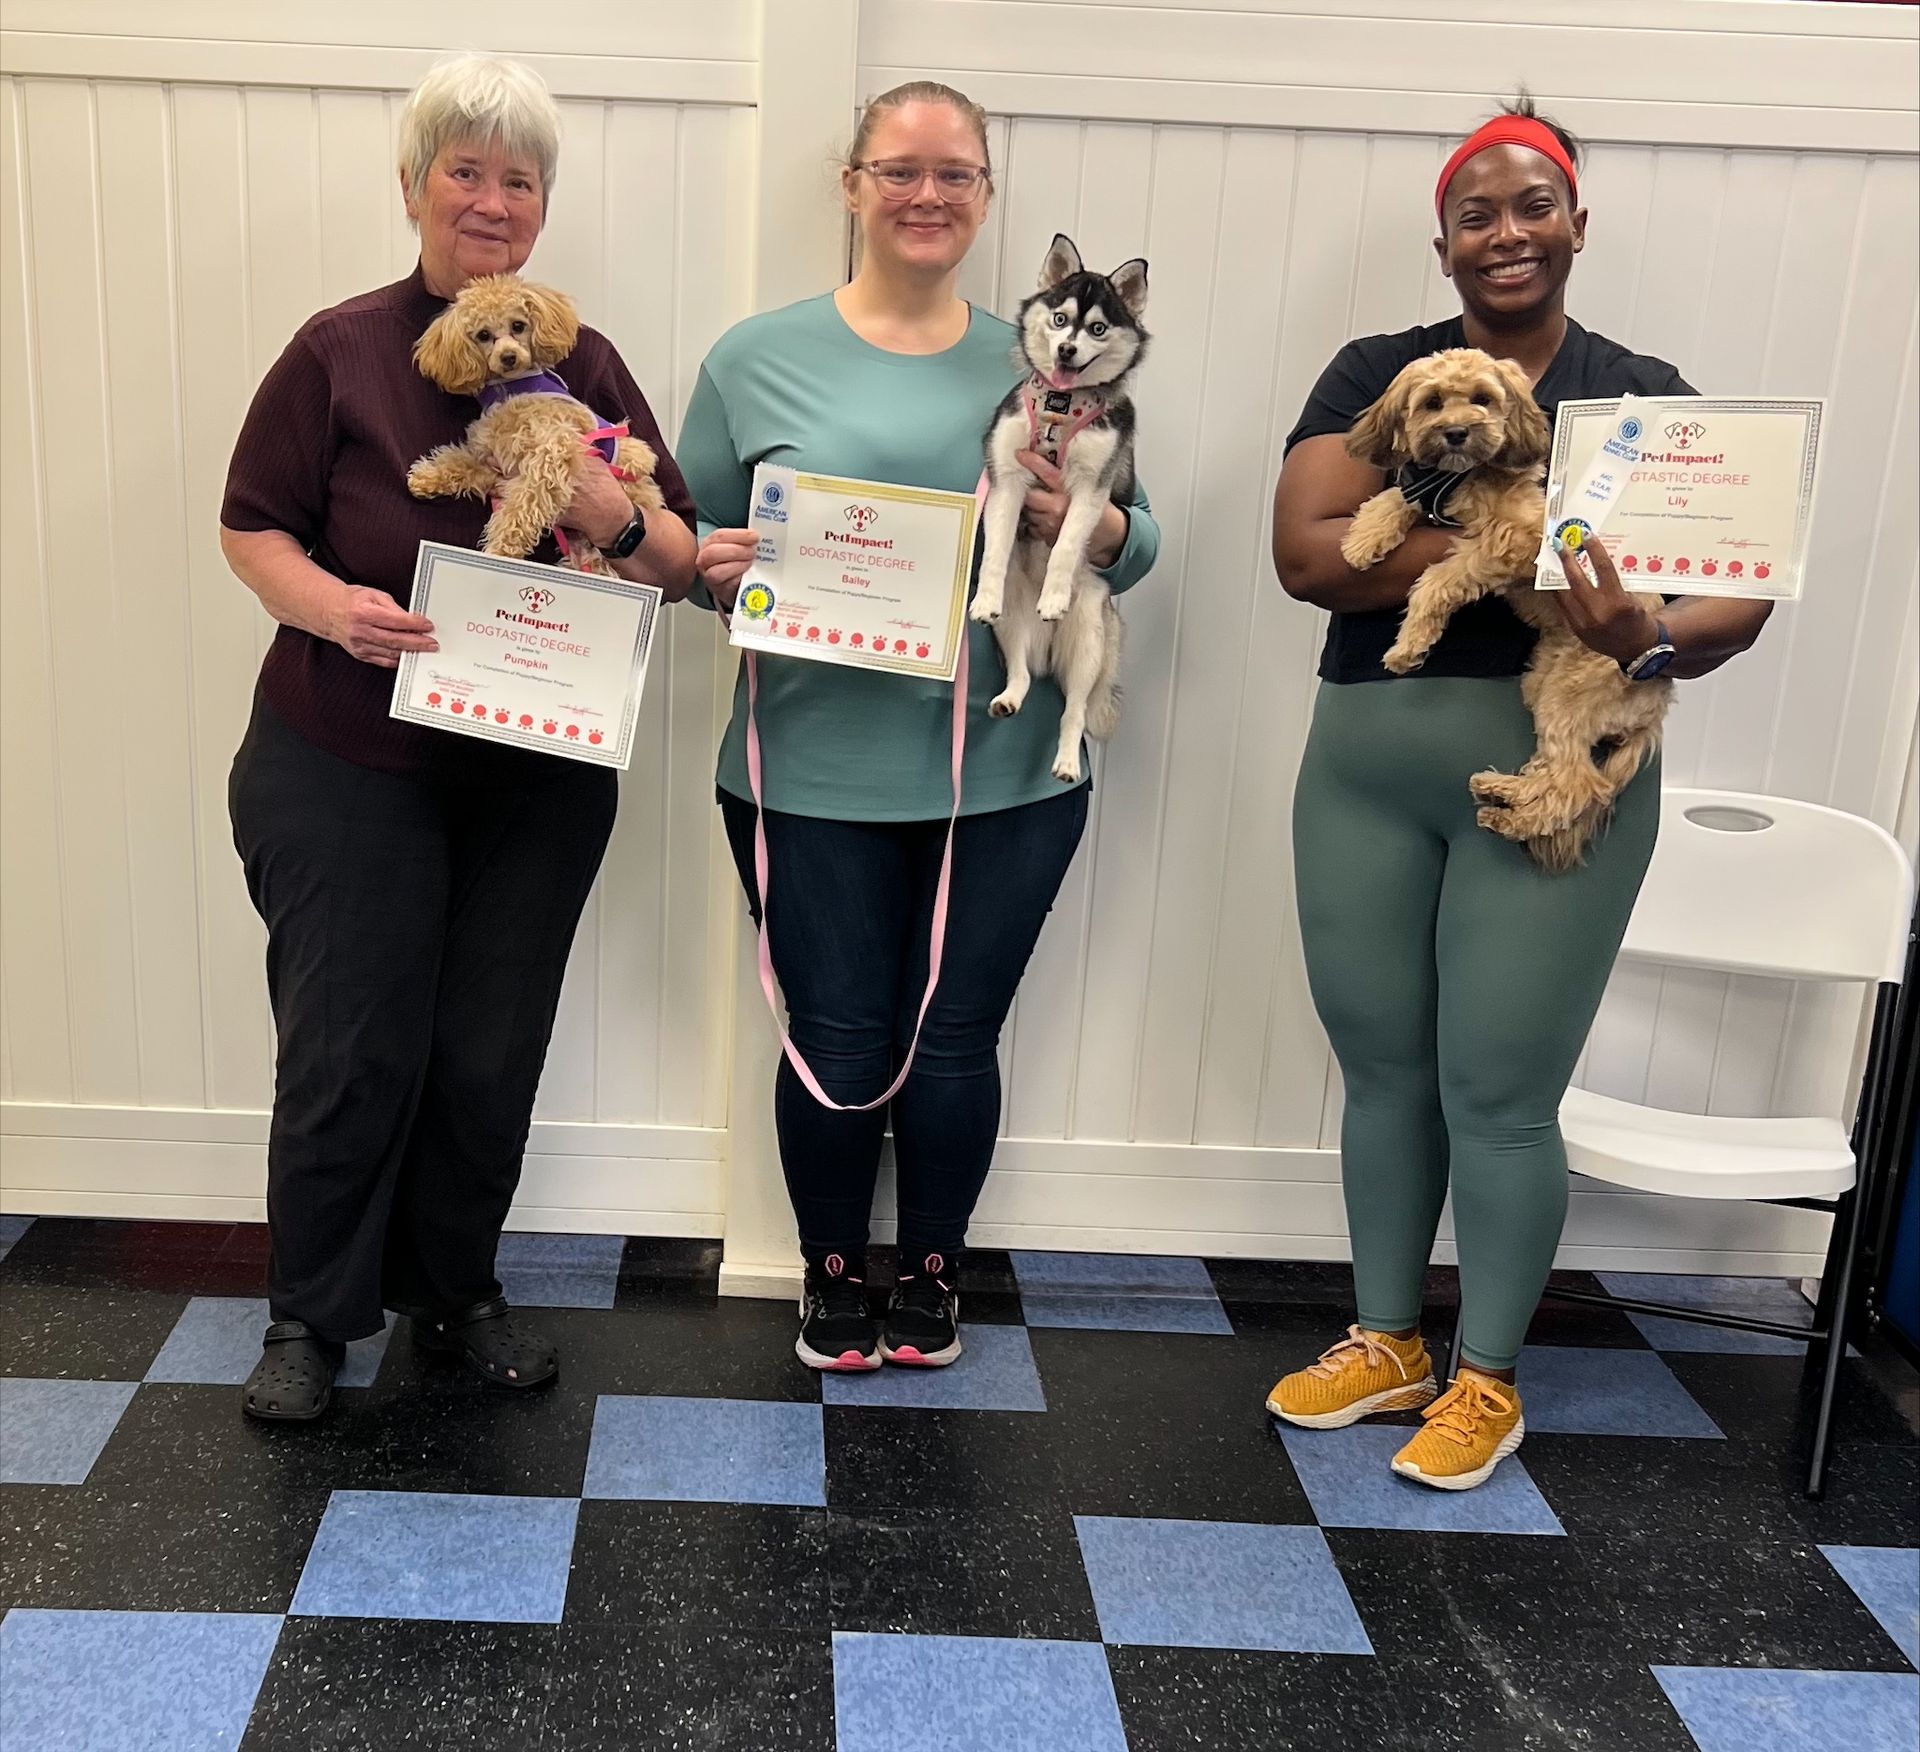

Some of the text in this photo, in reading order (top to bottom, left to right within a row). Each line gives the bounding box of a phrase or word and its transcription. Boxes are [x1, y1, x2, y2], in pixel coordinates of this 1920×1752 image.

[1606, 438, 1639, 456] AMERICAN
[1641, 452, 1724, 465] PetImpact!
[1630, 471, 1750, 485] GTASTIC DEGREE
[1668, 496, 1688, 507] Lily
[756, 505, 787, 517] AMERICAN
[824, 530, 894, 549] PetImpact!
[800, 546, 915, 571] DOGTASTIC DEGREE
[842, 574, 870, 588] Bailey
[496, 609, 570, 633] PetImpact!
[466, 622, 591, 657] DOGTASTIC DEGREE
[504, 653, 548, 670] Pumpkin
